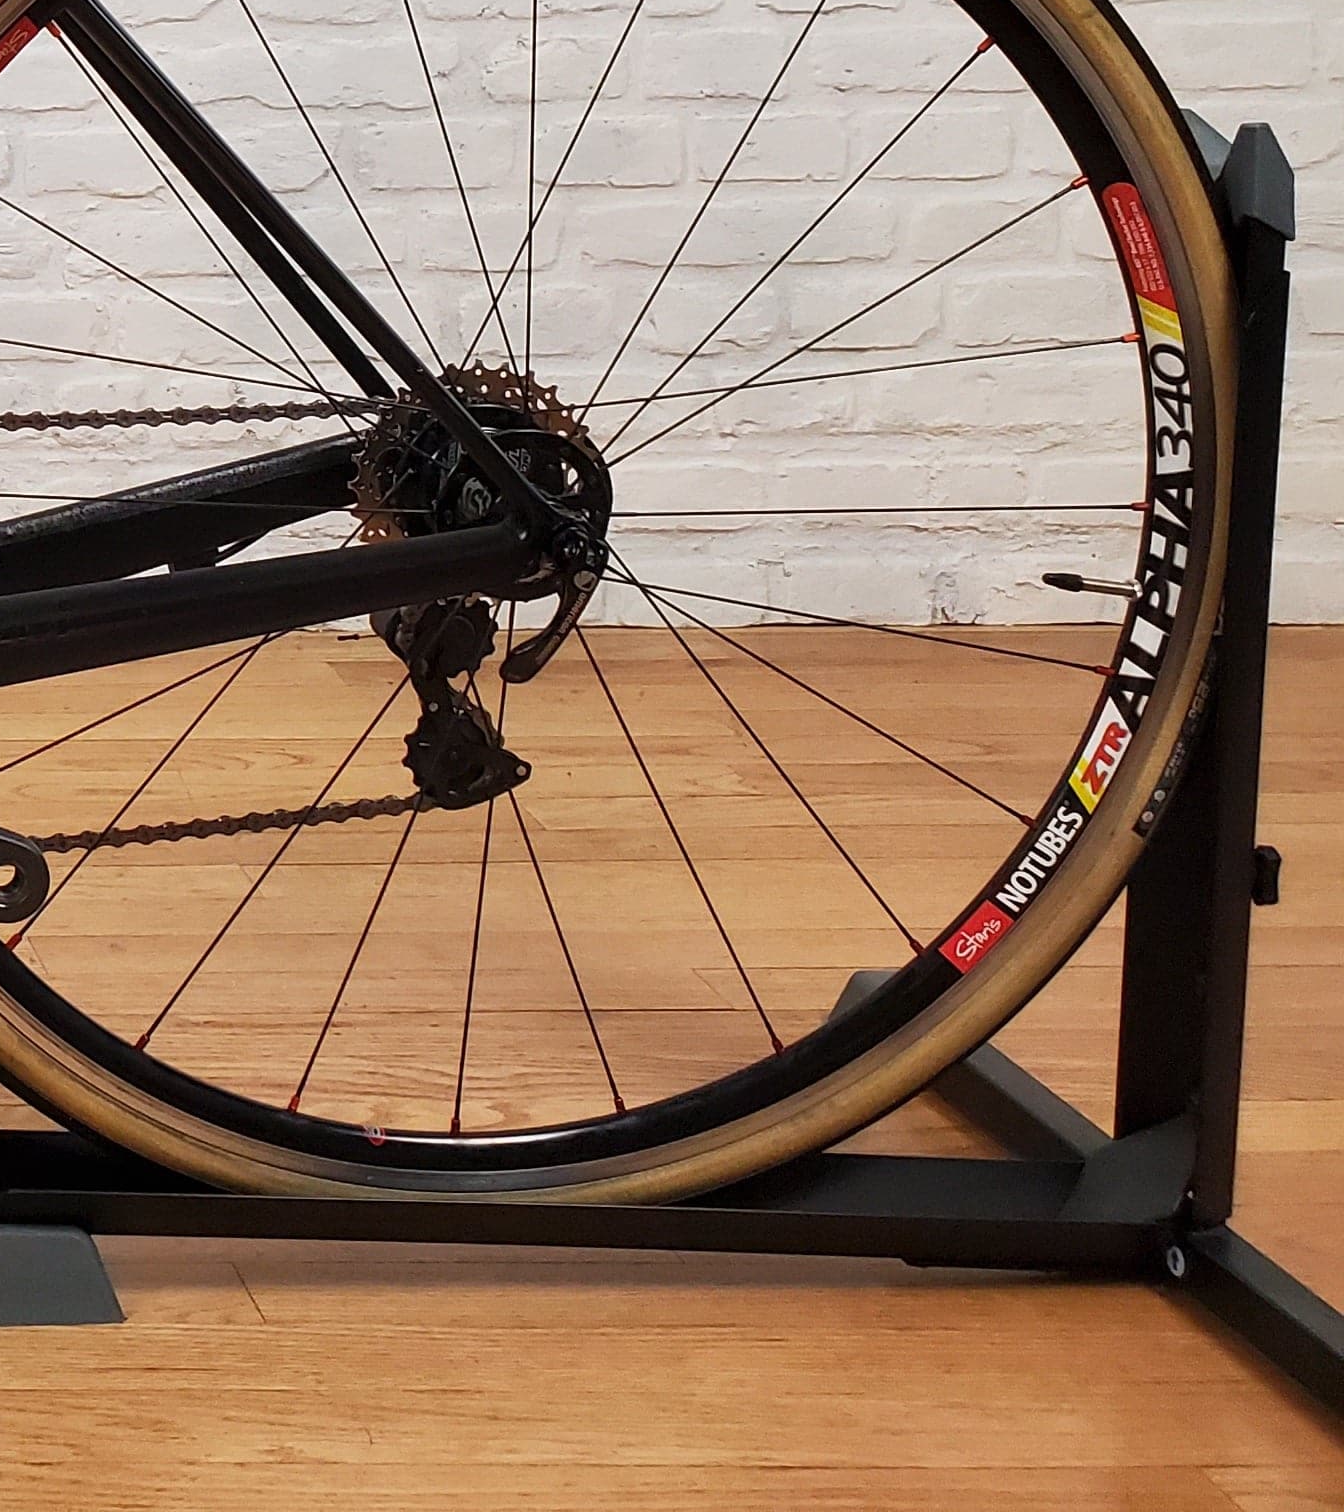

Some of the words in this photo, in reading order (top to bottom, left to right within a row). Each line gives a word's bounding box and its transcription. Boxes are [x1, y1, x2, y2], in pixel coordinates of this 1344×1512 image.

[1152, 343, 1191, 460] 340
[1112, 474, 1194, 732] ALPHA
[1080, 720, 1129, 794] ZTR
[996, 809, 1084, 912] NOTUBES
[957, 915, 1003, 962] Stan's
